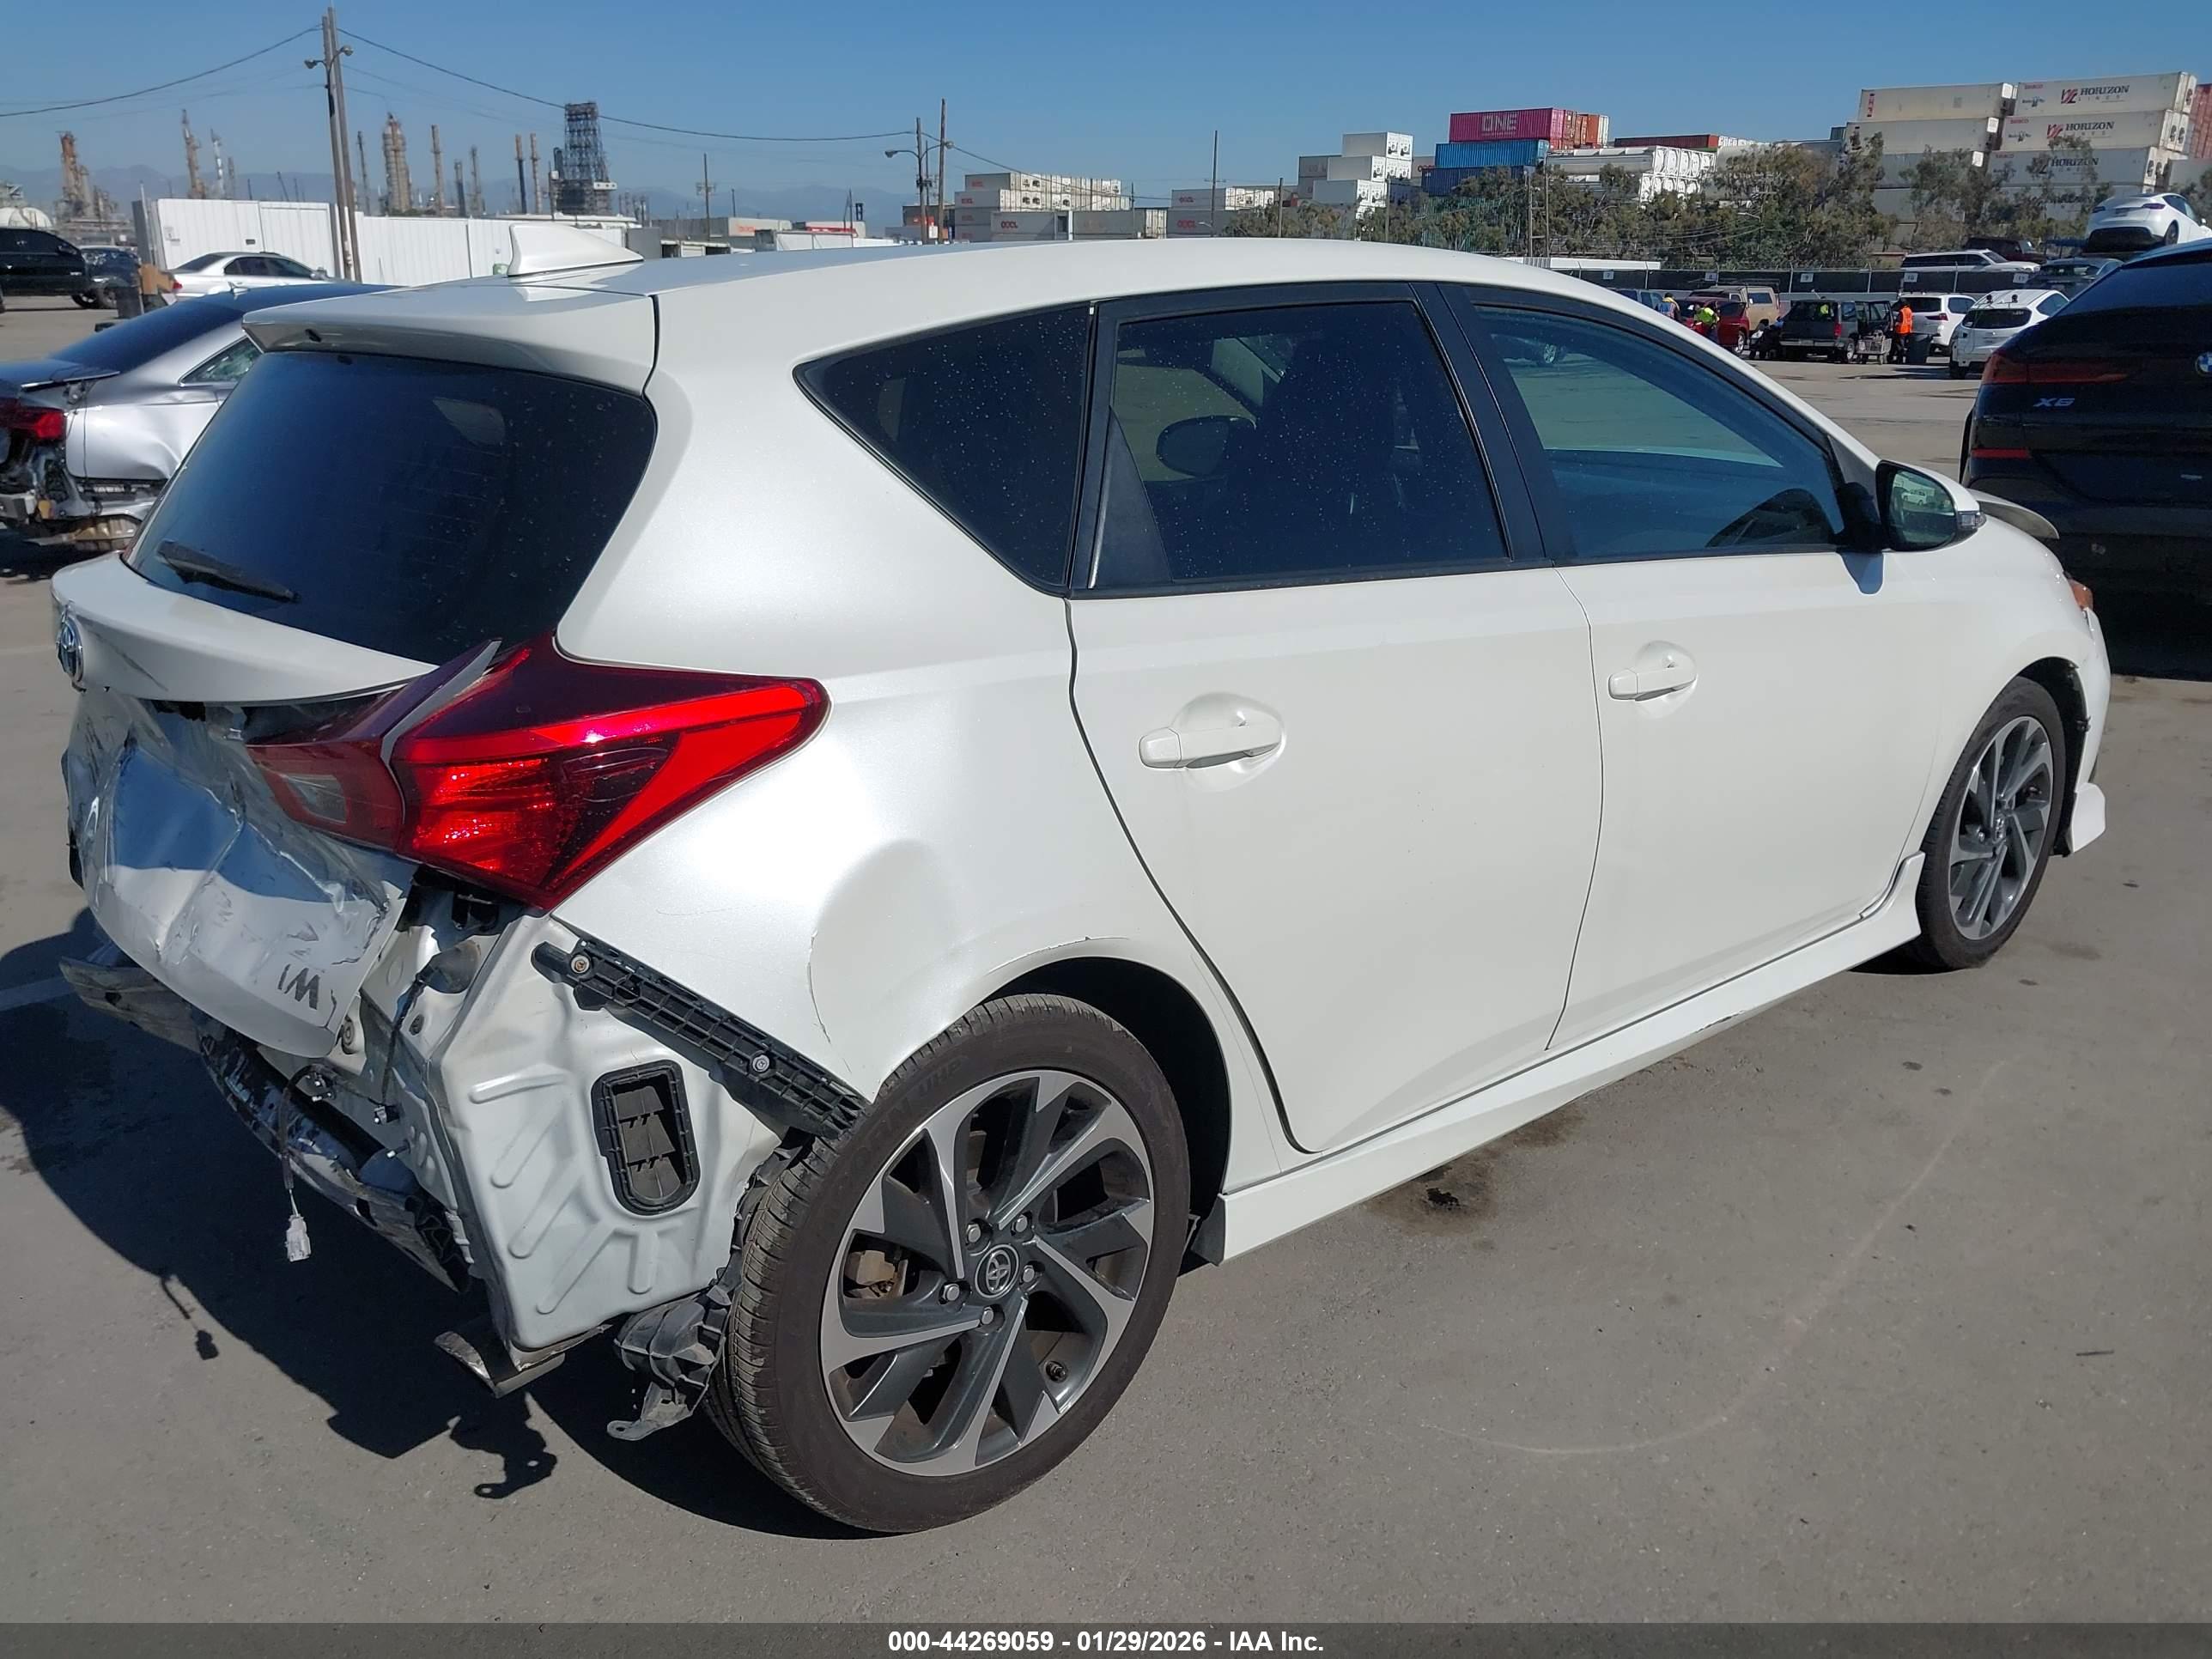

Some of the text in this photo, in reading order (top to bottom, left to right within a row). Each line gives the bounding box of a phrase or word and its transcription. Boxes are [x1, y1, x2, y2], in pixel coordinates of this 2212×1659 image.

[2080, 84, 2130, 96] HORIZON
[1482, 112, 1517, 131] ONE
[2065, 121, 2114, 131] HORIZON
[1000, 221, 1018, 229] OOCL
[2033, 397, 2075, 407] X6
